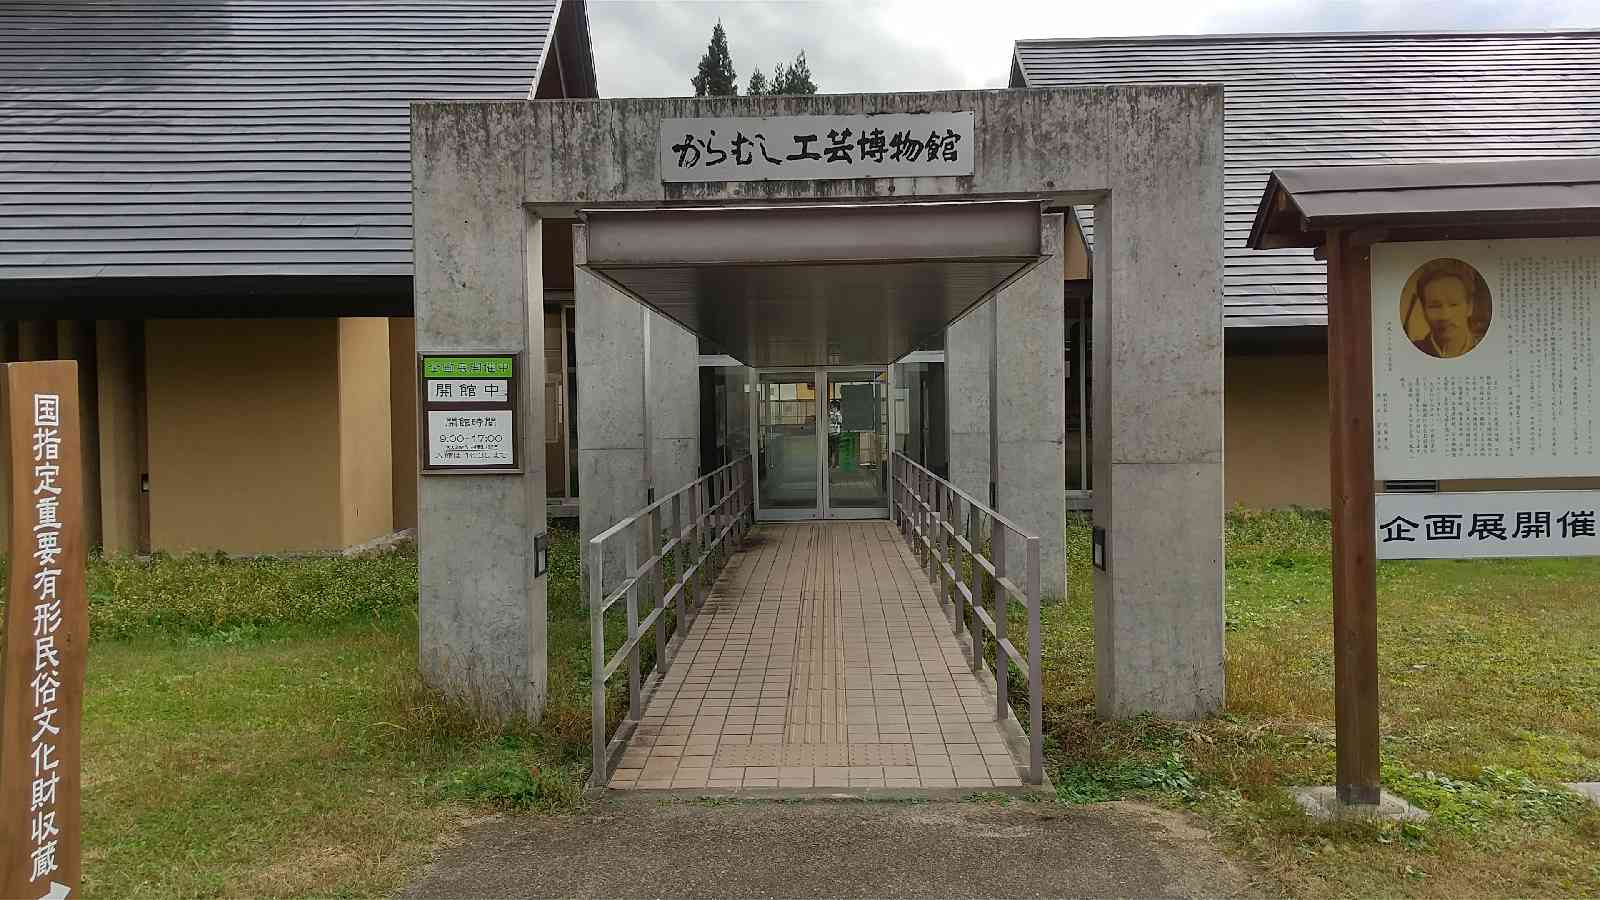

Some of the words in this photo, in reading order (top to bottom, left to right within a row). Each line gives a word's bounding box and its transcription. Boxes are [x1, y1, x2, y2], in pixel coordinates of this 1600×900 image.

[671, 127, 961, 168] からむし工芸博物館
[436, 383, 499, 398] 開館中
[1380, 510, 1596, 543] 企画展開催
[30, 393, 63, 882] 国指定重要有形民俗文化財収蔵
